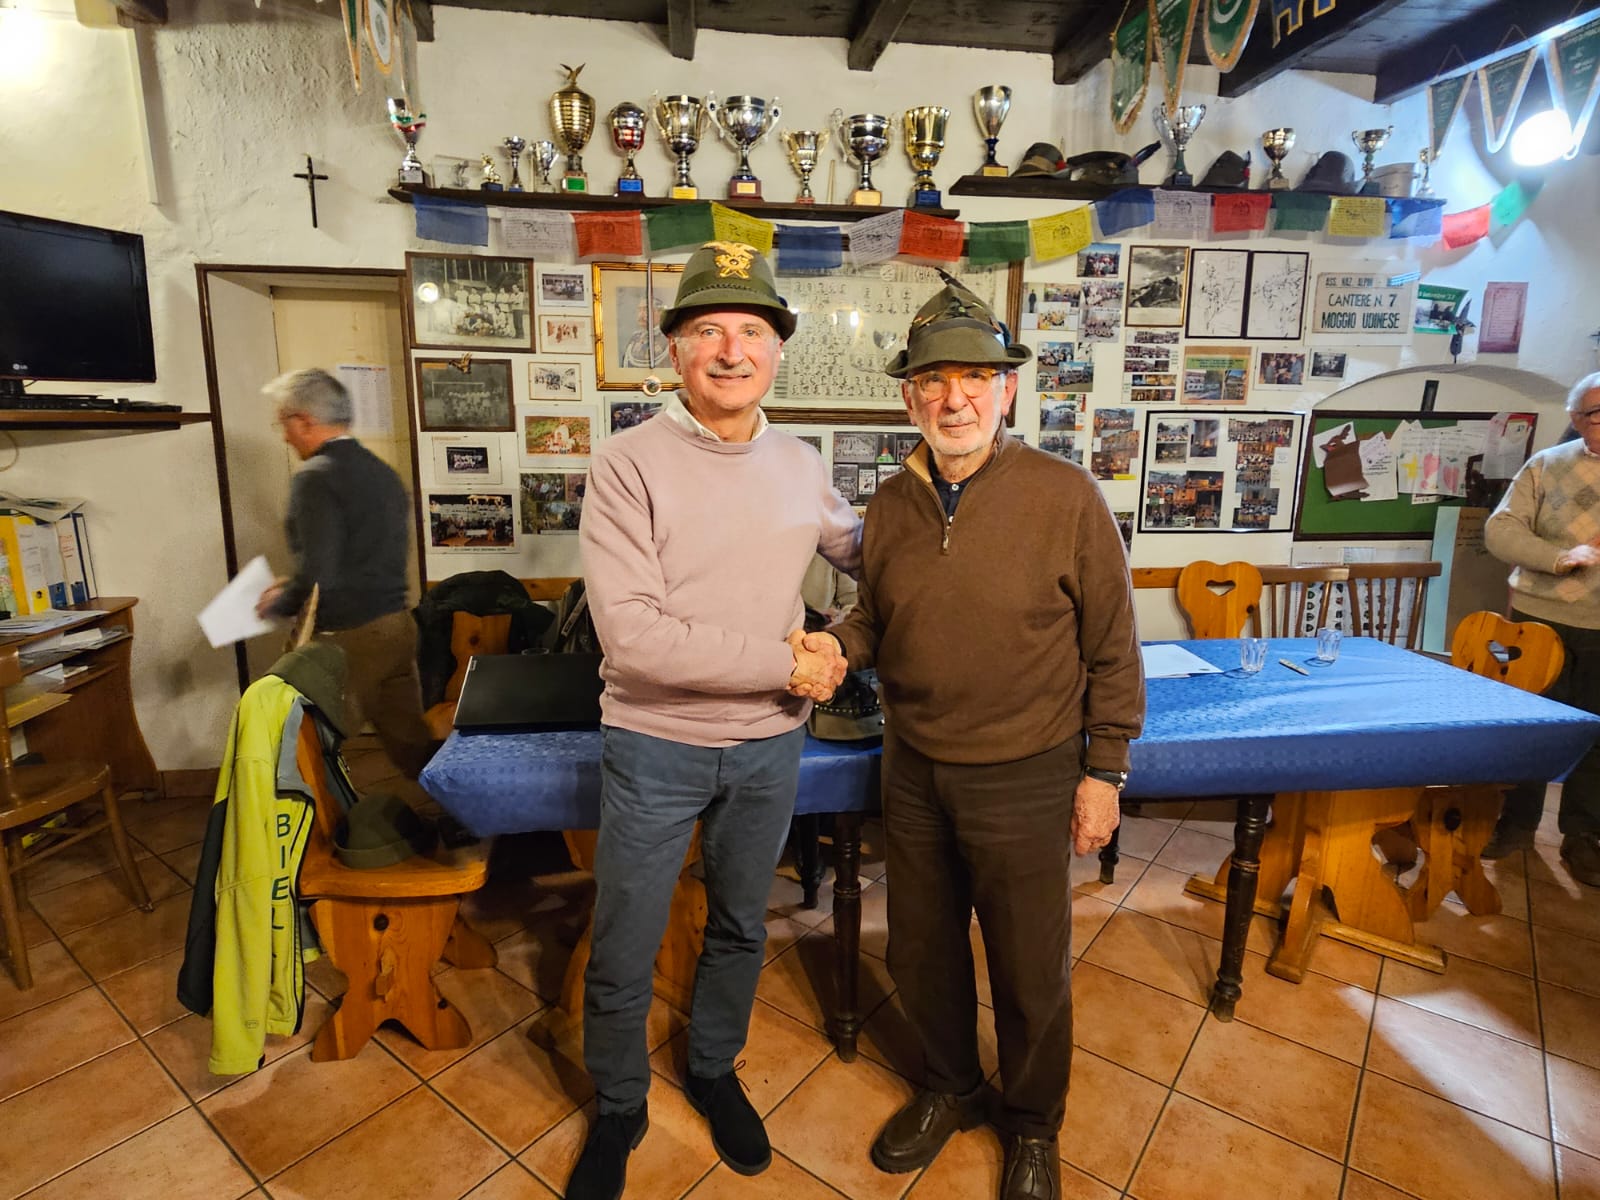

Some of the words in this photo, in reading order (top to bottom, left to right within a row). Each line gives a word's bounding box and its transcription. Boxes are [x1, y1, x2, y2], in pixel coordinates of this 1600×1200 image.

[1328, 293, 1372, 307] CANTIERE
[1389, 294, 1398, 307] 7
[1321, 311, 1357, 329] MOGGIO
[1362, 312, 1400, 329] UDINESE
[271, 813, 291, 984] BIEL
